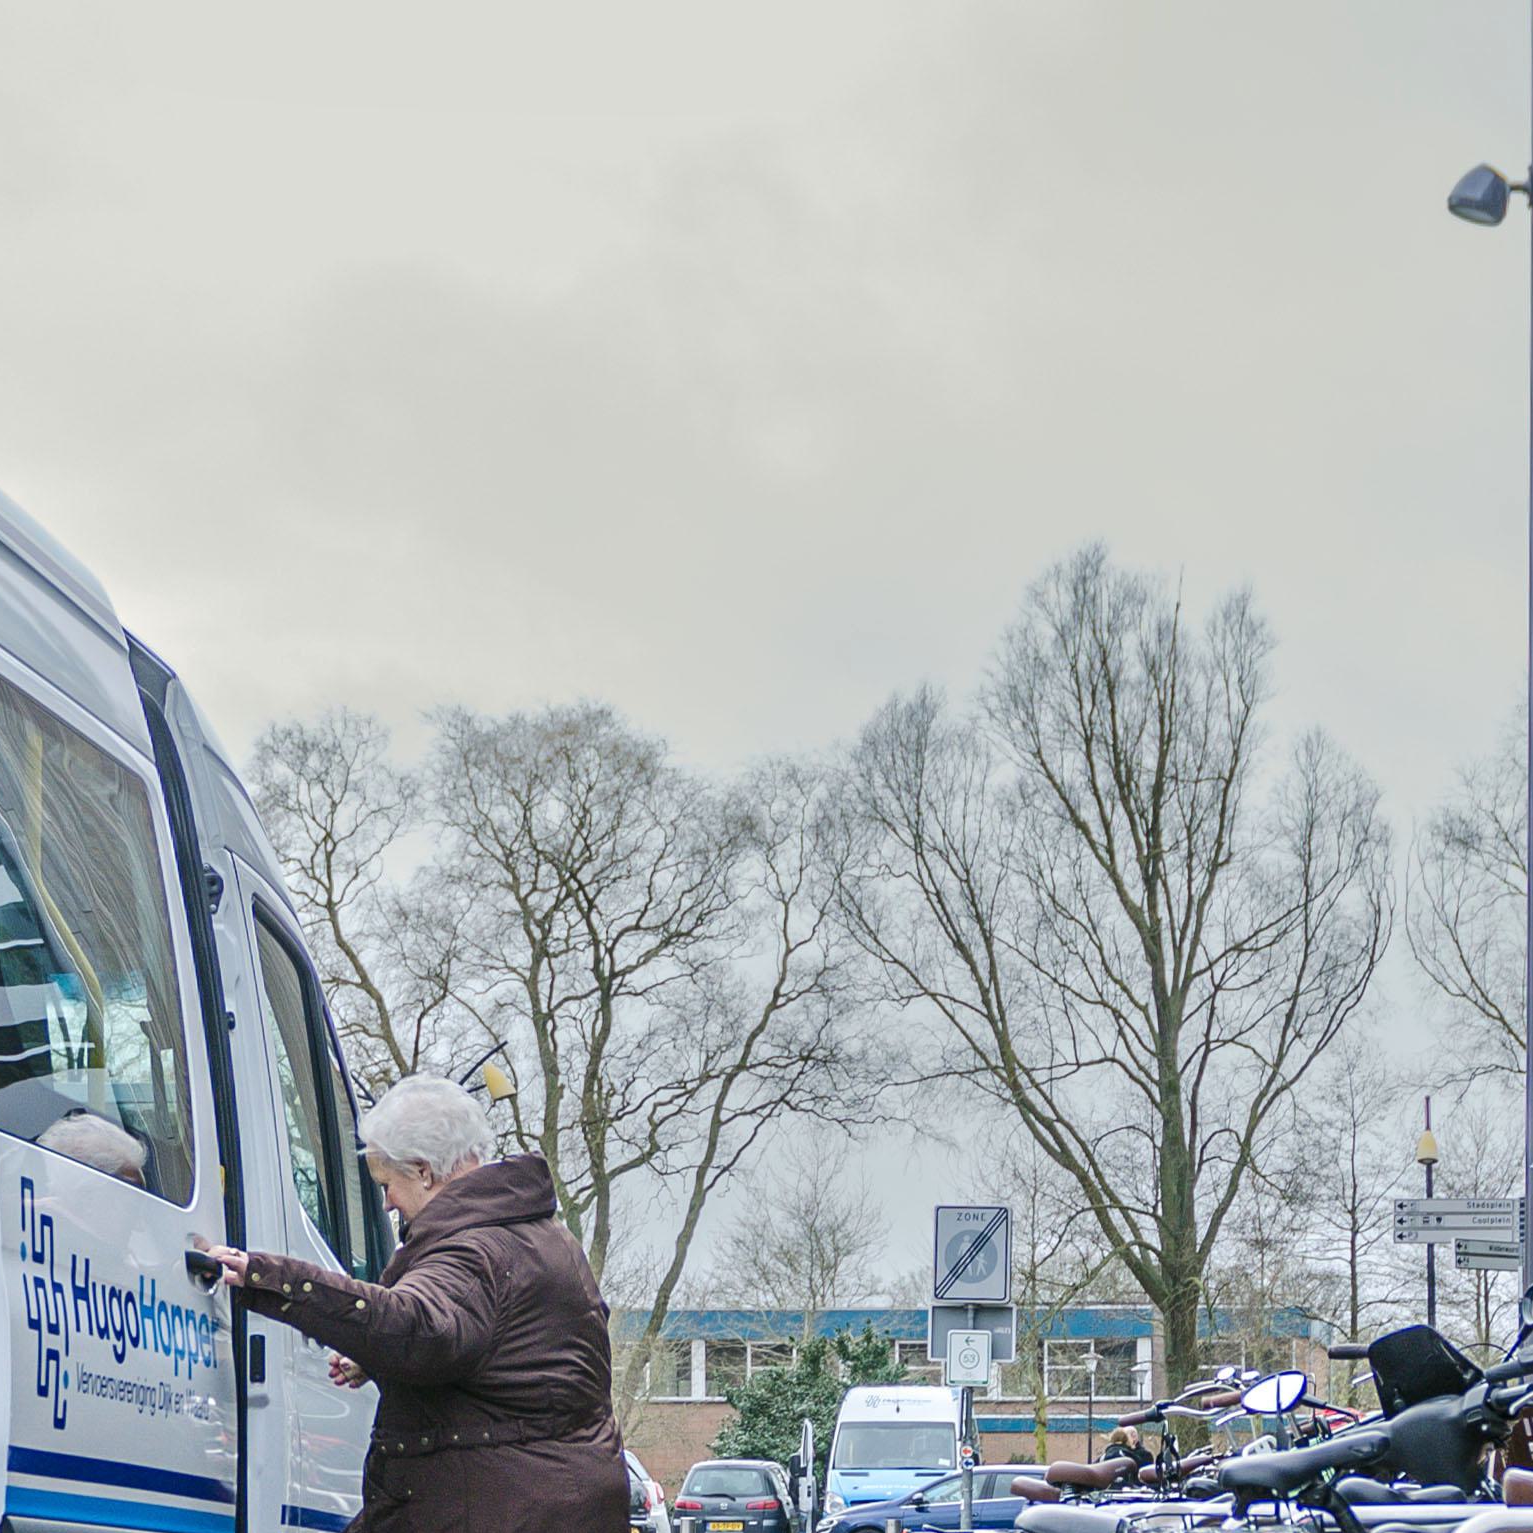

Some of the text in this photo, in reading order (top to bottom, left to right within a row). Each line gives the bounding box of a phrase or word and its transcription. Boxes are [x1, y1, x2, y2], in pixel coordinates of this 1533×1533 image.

[957, 1212, 986, 1222] ZONE
[71, 1254, 221, 1380] HugoHopper
[76, 1362, 156, 1416] Vervoersvereniging
